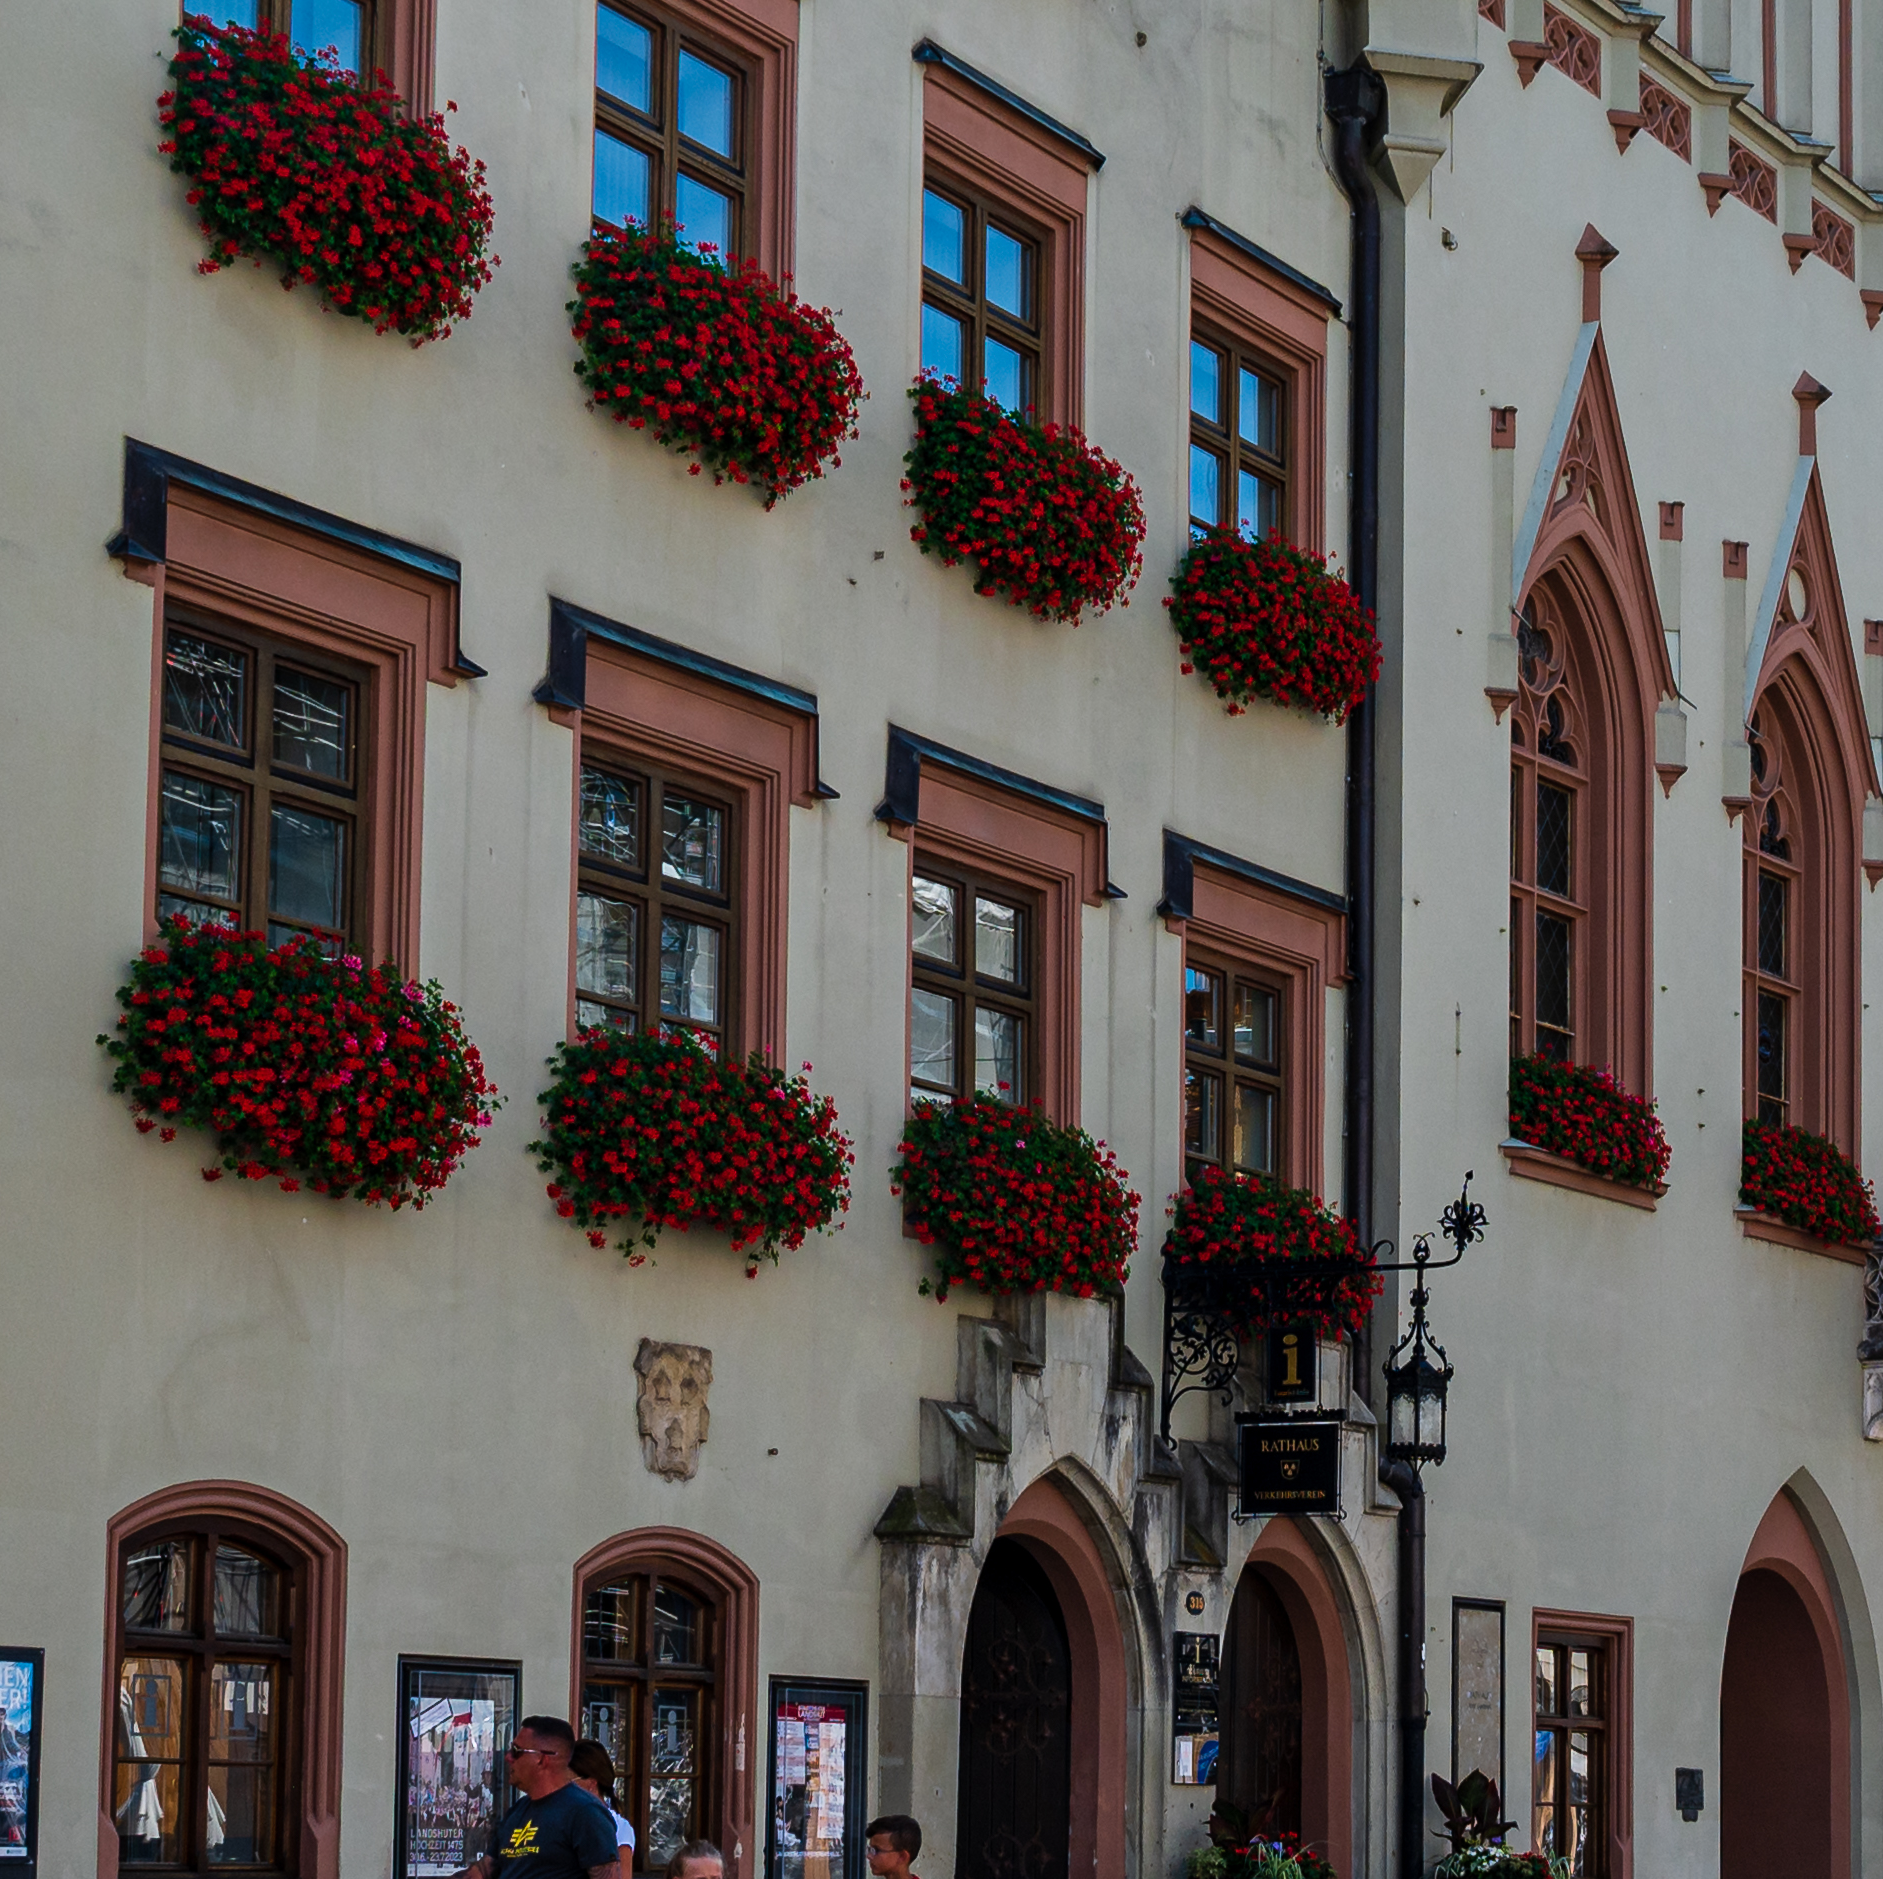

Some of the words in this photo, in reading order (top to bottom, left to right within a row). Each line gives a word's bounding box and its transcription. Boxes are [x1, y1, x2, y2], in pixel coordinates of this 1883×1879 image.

[1261, 1438, 1320, 1452] RATHAUS
[1254, 1490, 1326, 1499] VERKEHRSVEREIN
[1189, 1595, 1204, 1610] 315
[410, 1828, 464, 1838] LANDSHUTER
